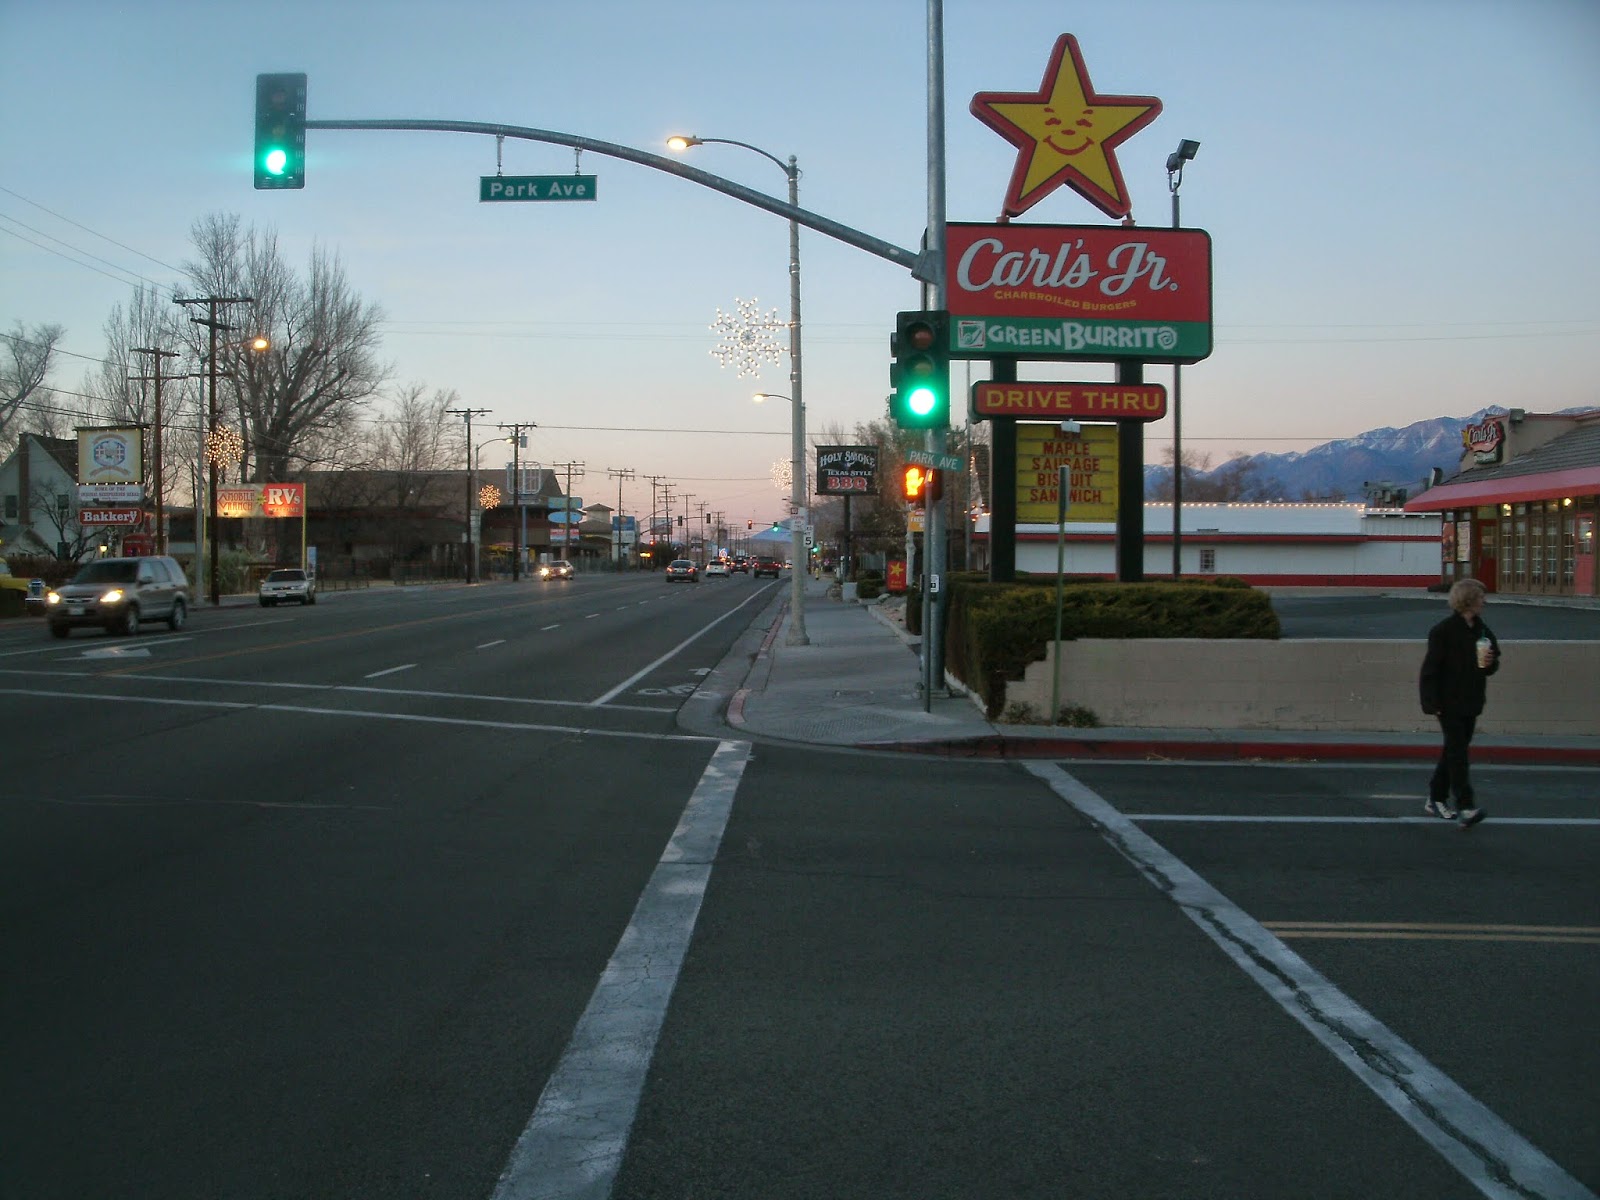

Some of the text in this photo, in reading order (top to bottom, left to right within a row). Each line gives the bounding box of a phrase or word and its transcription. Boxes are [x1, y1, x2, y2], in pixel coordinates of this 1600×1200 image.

[490, 181, 586, 197] Park Ave
[956, 238, 1179, 296] Carl's Jr.
[986, 389, 1161, 410] DRIVE THRU
[1042, 441, 1091, 456] MAPLE
[820, 450, 876, 469] HOLY SMOKE
[909, 450, 959, 470] PARK AVE
[1031, 457, 1100, 472] SAUSAGE
[827, 476, 868, 491] BBQ
[1037, 473, 1093, 487] BISUIT
[227, 492, 255, 502] MOBILE
[267, 488, 301, 505] RVs
[1029, 488, 1102, 503] SANWICH
[227, 501, 253, 511] RANCH
